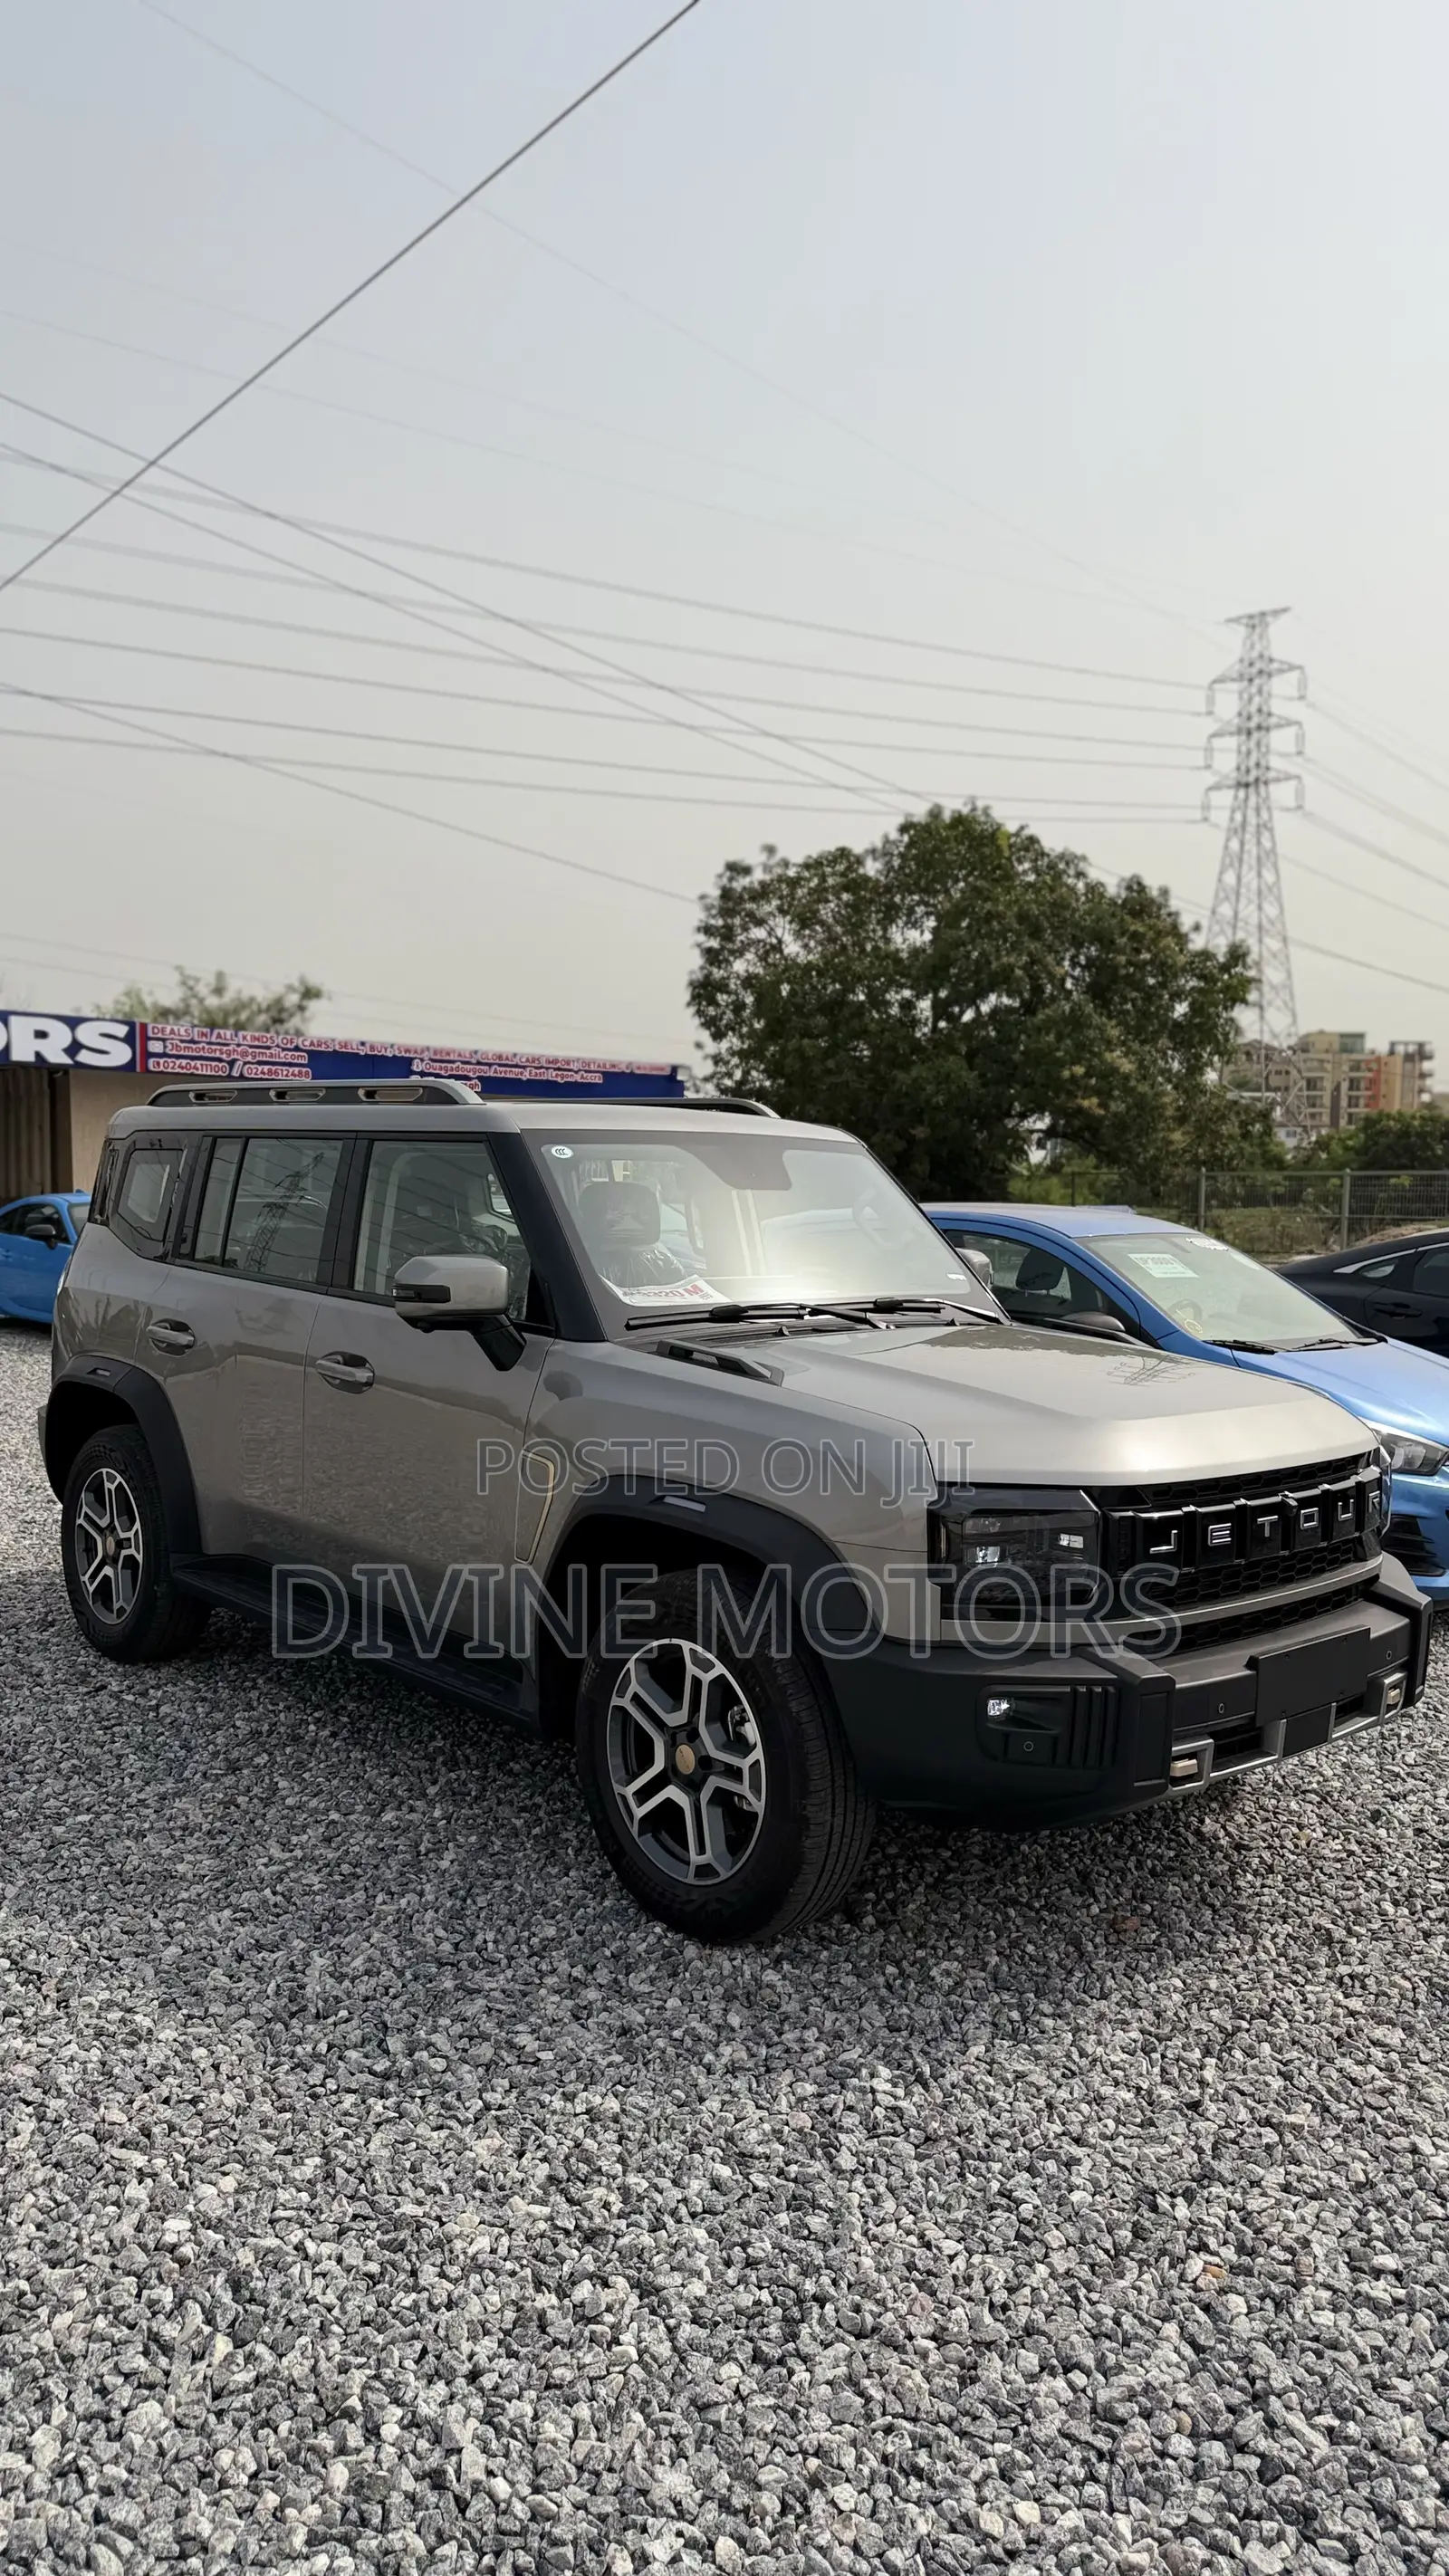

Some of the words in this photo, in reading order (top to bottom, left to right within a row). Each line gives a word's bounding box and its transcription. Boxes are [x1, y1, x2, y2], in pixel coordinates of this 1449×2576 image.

[0, 1015, 133, 1068] RS
[150, 1025, 192, 1039] DEALS
[197, 1028, 209, 1040] IN
[215, 1030, 236, 1042] ALL
[241, 1033, 277, 1045] KINDS
[281, 1036, 297, 1047] OF
[479, 1051, 515, 1063] GLOBAL
[518, 1056, 542, 1065] CARS
[167, 1041, 307, 1064] Jbmotorsgh@gmail.com
[162, 1059, 228, 1075] 0240411100
[245, 1066, 312, 1080] 0248612488
[424, 1061, 488, 1076] Ouagadougou
[528, 1068, 547, 1078] East
[580, 1073, 603, 1083] Accra
[1149, 1490, 1381, 1554] JETOUR
